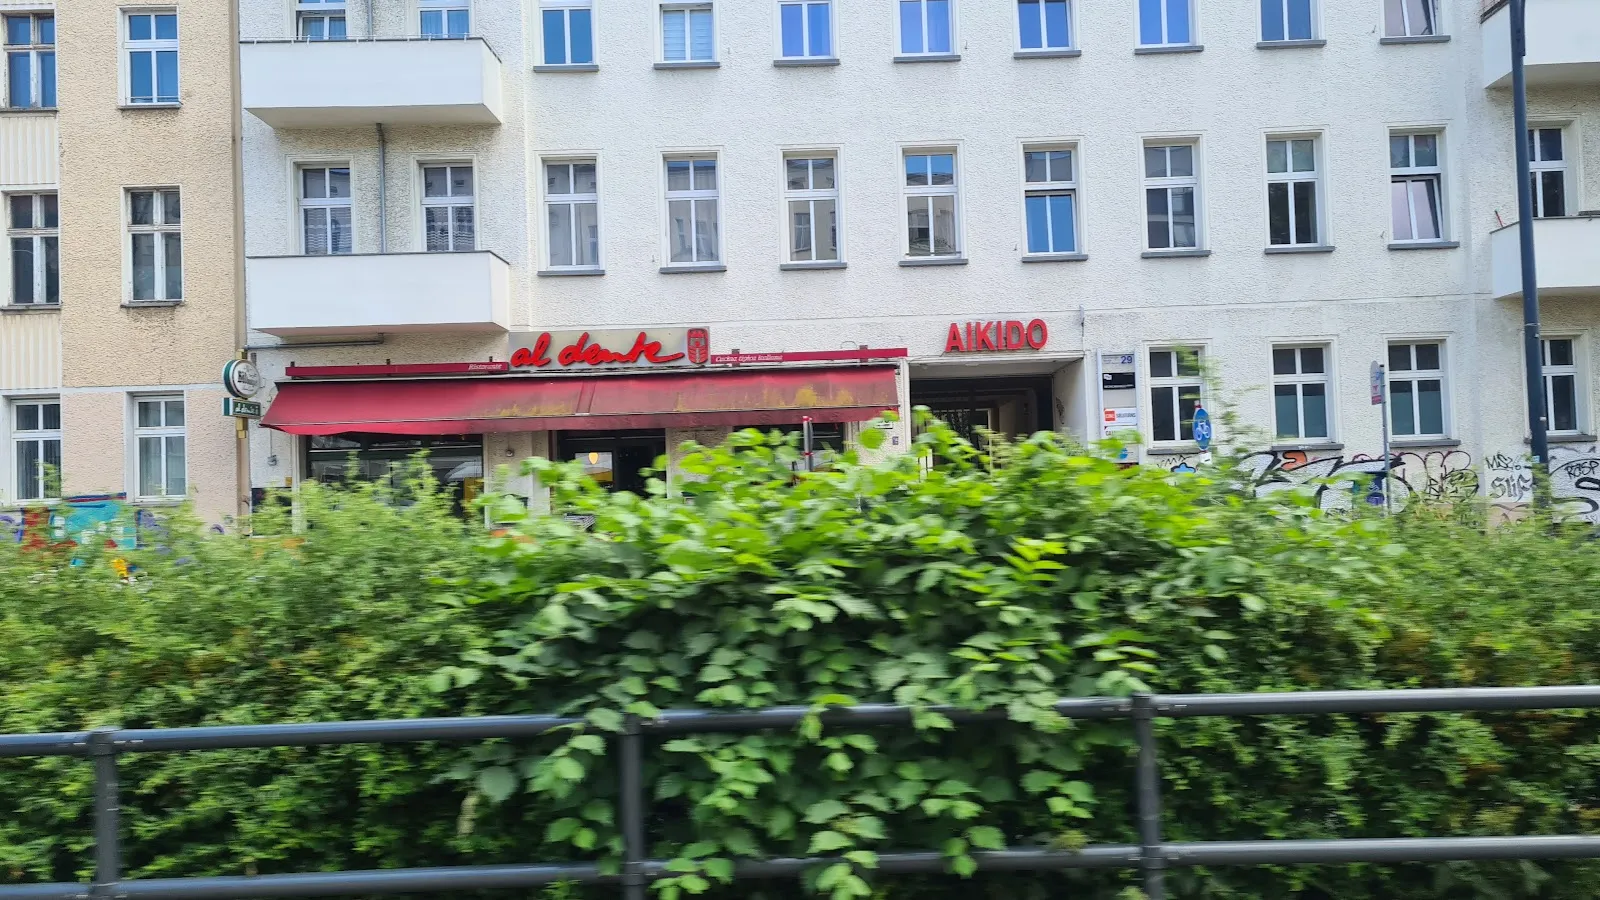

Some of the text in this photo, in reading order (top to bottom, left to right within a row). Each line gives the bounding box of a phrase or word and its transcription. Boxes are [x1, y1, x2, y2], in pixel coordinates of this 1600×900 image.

[945, 318, 1048, 352] AIKIDO
[510, 331, 685, 367] al dente
[1120, 355, 1133, 364] 29
[468, 363, 503, 371] Ristorante
